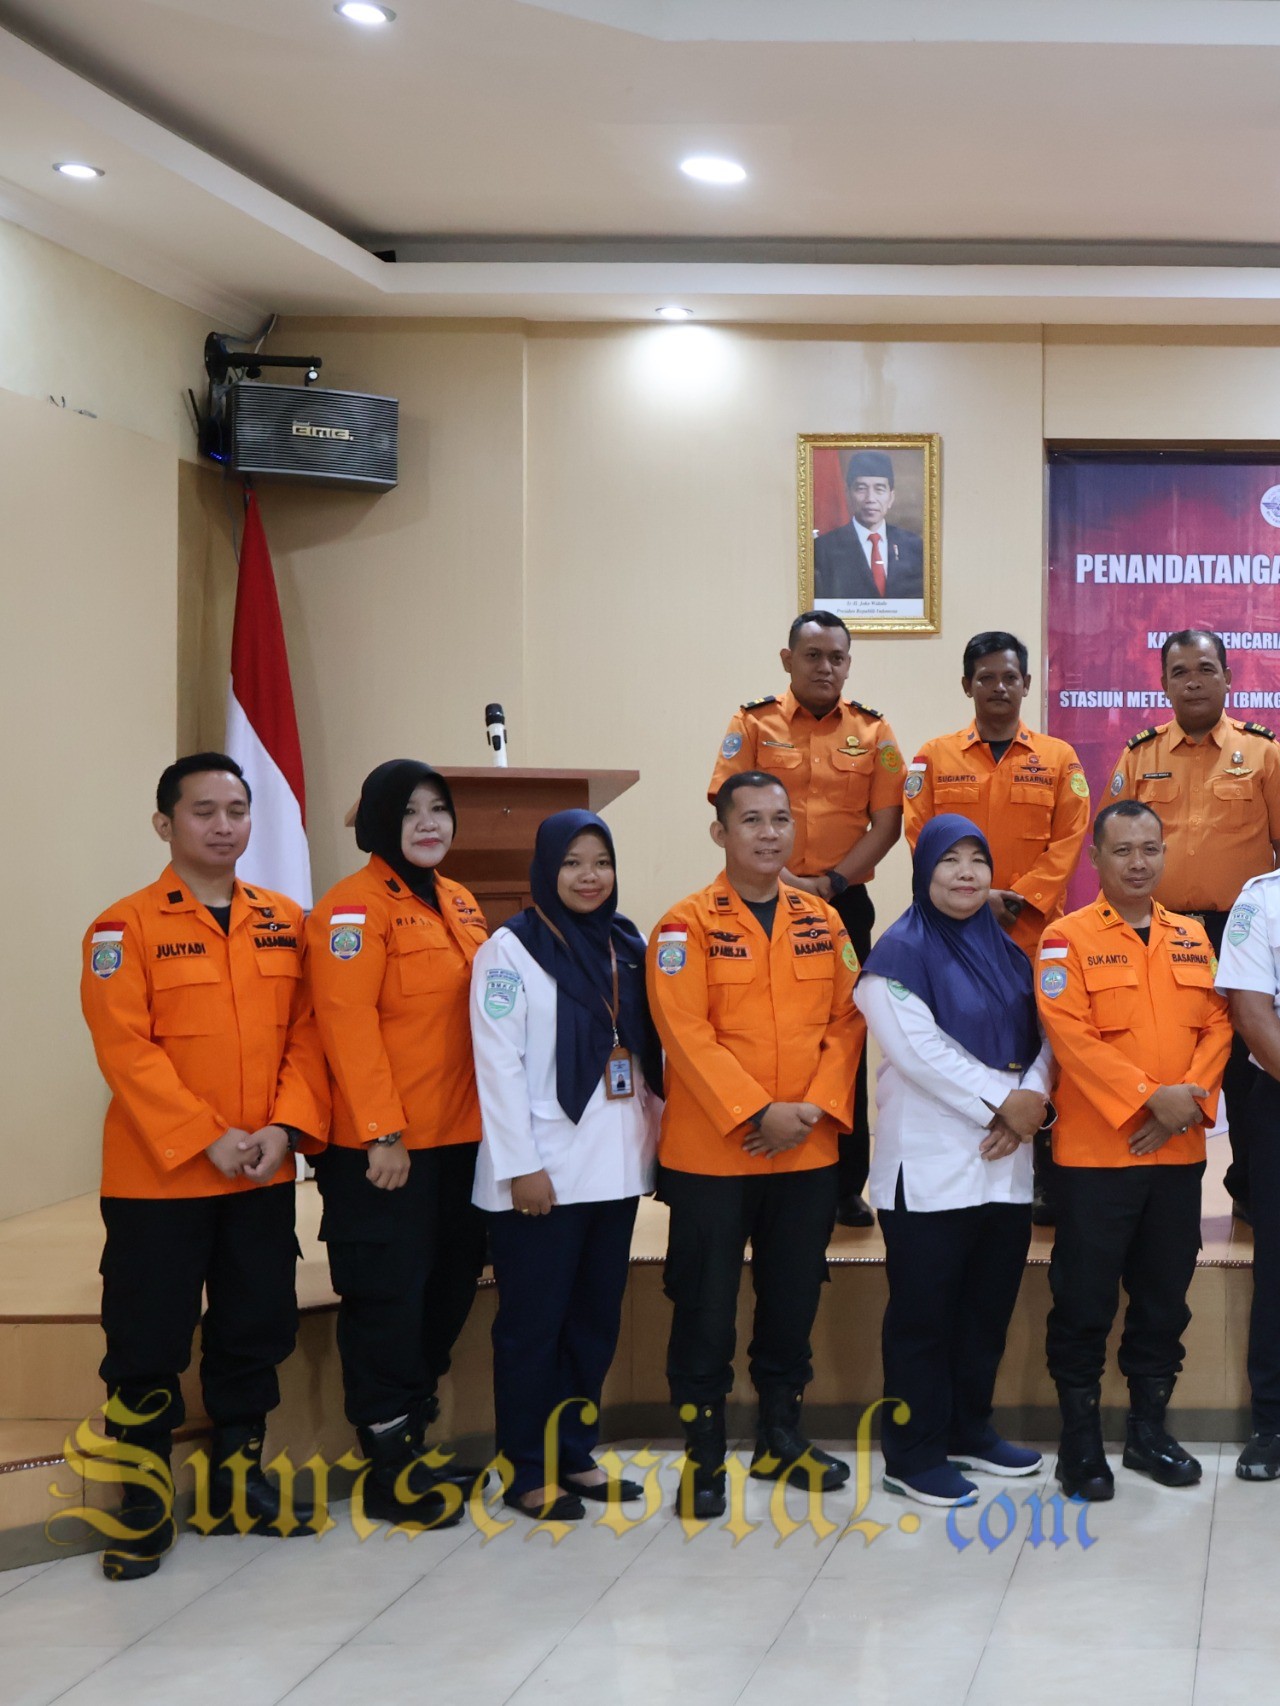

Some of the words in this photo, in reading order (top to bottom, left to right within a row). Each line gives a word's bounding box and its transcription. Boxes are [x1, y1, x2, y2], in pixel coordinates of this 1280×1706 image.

[1059, 691, 1124, 708] STASIUN
[937, 775, 977, 783] SUGIANTO
[1014, 775, 1053, 786] BASARNAS
[156, 943, 206, 958] JULIYADI
[1087, 955, 1128, 966] SUKAMTO
[1172, 953, 1208, 964] BASARNAS
